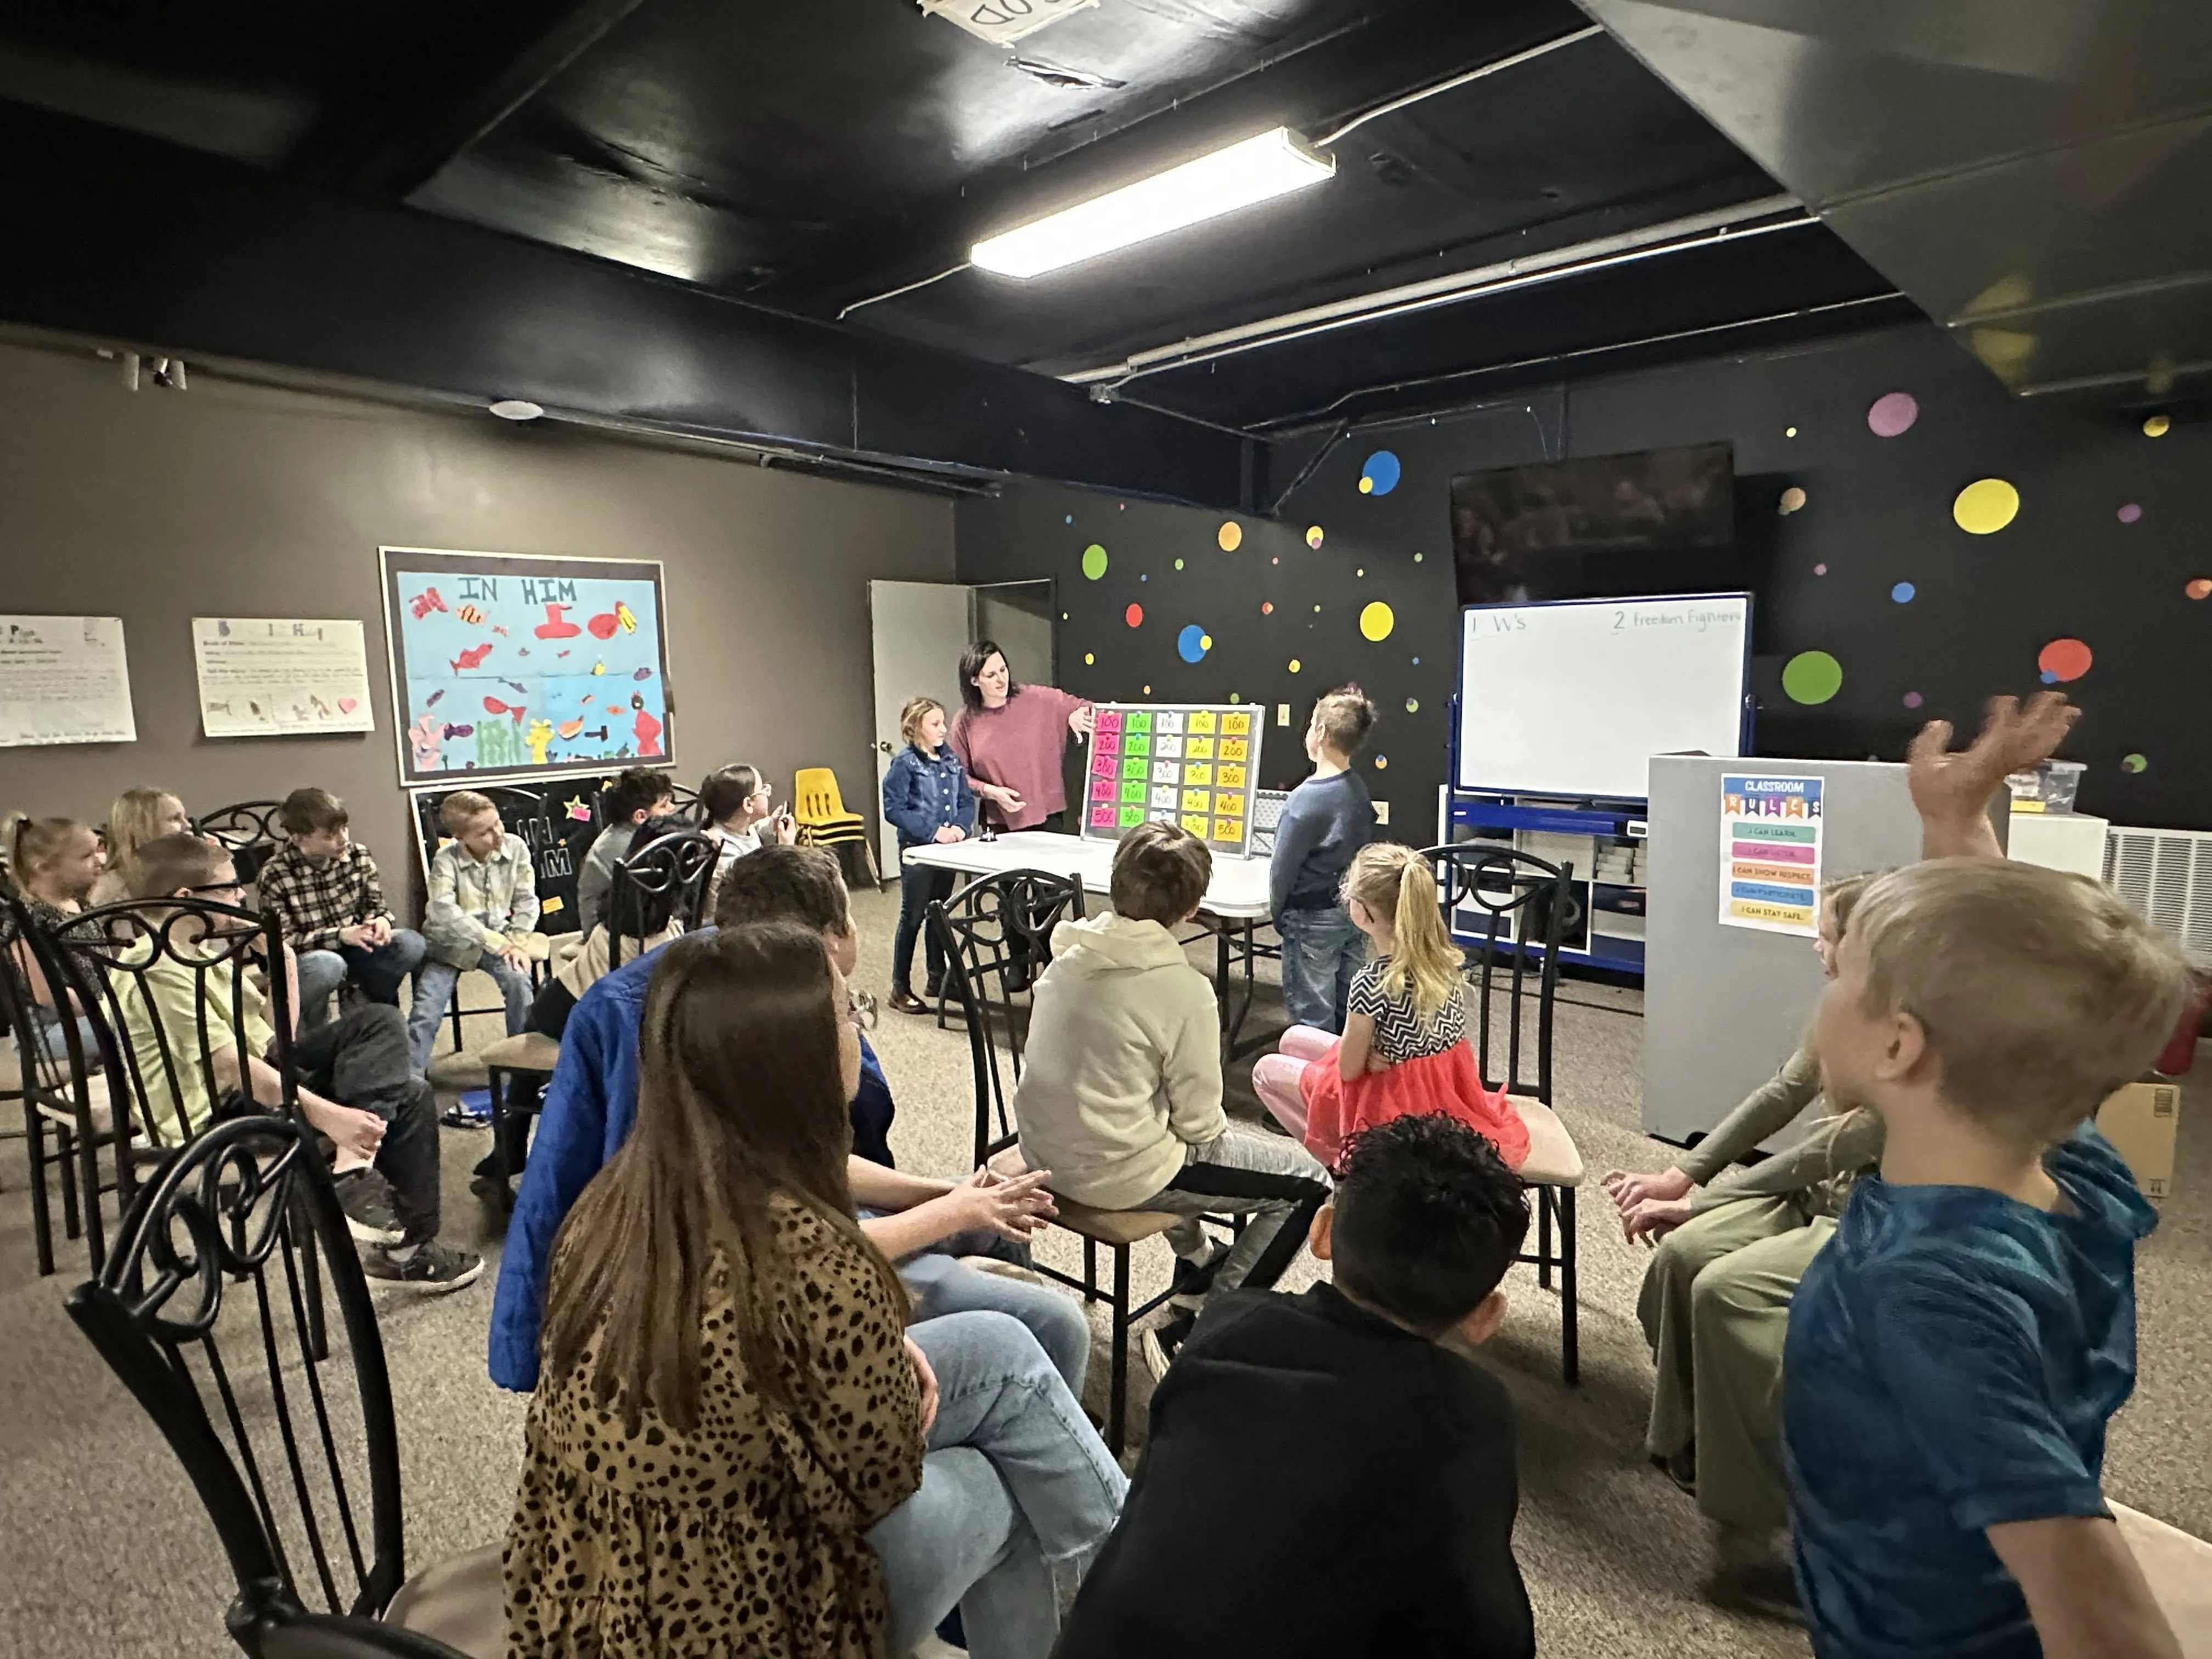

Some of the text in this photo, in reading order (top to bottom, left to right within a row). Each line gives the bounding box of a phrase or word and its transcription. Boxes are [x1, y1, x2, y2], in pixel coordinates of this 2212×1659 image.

[458, 577, 577, 605] IN HIM
[1493, 613, 1526, 632] W's
[1613, 611, 1625, 629] 2
[1101, 717, 1119, 728] 100
[1132, 718, 1147, 728] 100
[1161, 718, 1174, 728] 100
[1196, 718, 1209, 728] 100
[1229, 720, 1244, 730] 100
[1099, 740, 1115, 750] 200
[1128, 741, 1145, 751] 200
[1160, 742, 1176, 751] 200
[1223, 746, 1243, 756] 200
[1096, 760, 1113, 775] 300
[1158, 767, 1172, 778] 300
[1222, 772, 1239, 783] 300
[1096, 787, 1111, 797] 400
[1745, 781, 1804, 793] CLASSROOM
[1125, 788, 1141, 799] 400
[1155, 793, 1171, 804] 400
[1187, 798, 1203, 808] 400
[1220, 800, 1236, 811] 400
[1729, 796, 1820, 812] RULES
[1094, 810, 1114, 822] 500
[1125, 811, 1139, 822] 500
[1218, 825, 1235, 835] 500
[1755, 868, 1777, 876] SHOW
[1764, 909, 1781, 917] STAY
